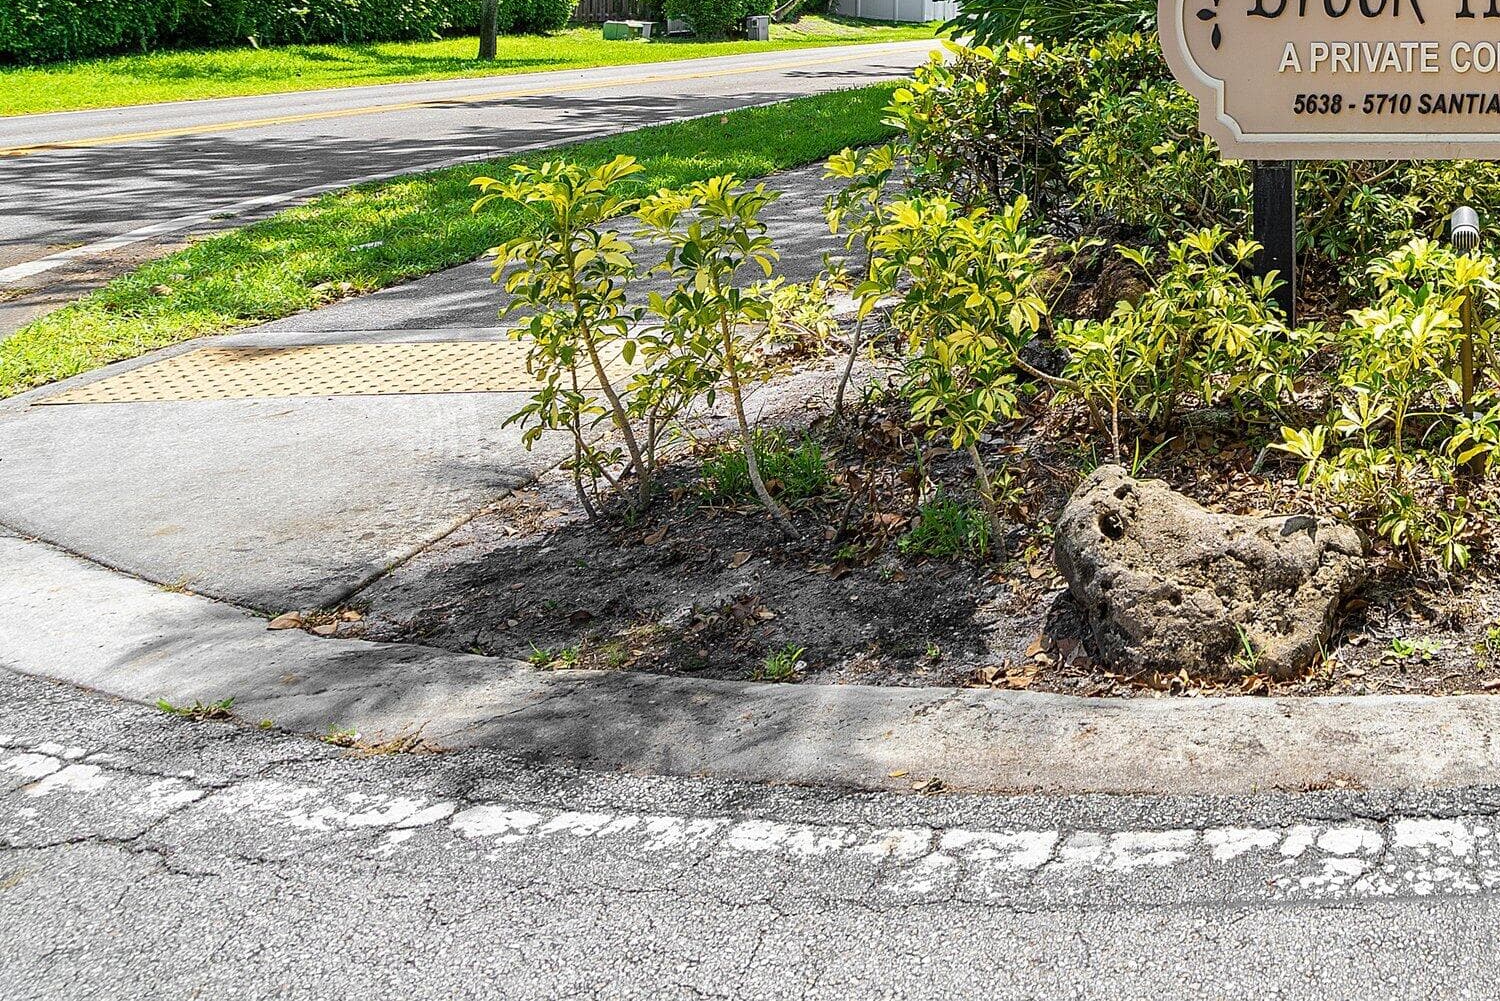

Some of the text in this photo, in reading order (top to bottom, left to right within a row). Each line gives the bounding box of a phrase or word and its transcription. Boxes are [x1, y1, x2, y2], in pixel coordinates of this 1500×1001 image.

[1278, 41, 1303, 73] A
[1309, 41, 1440, 73] PRIVATE
[1293, 93, 1343, 115] 5638
[1362, 93, 1412, 115] 5710
